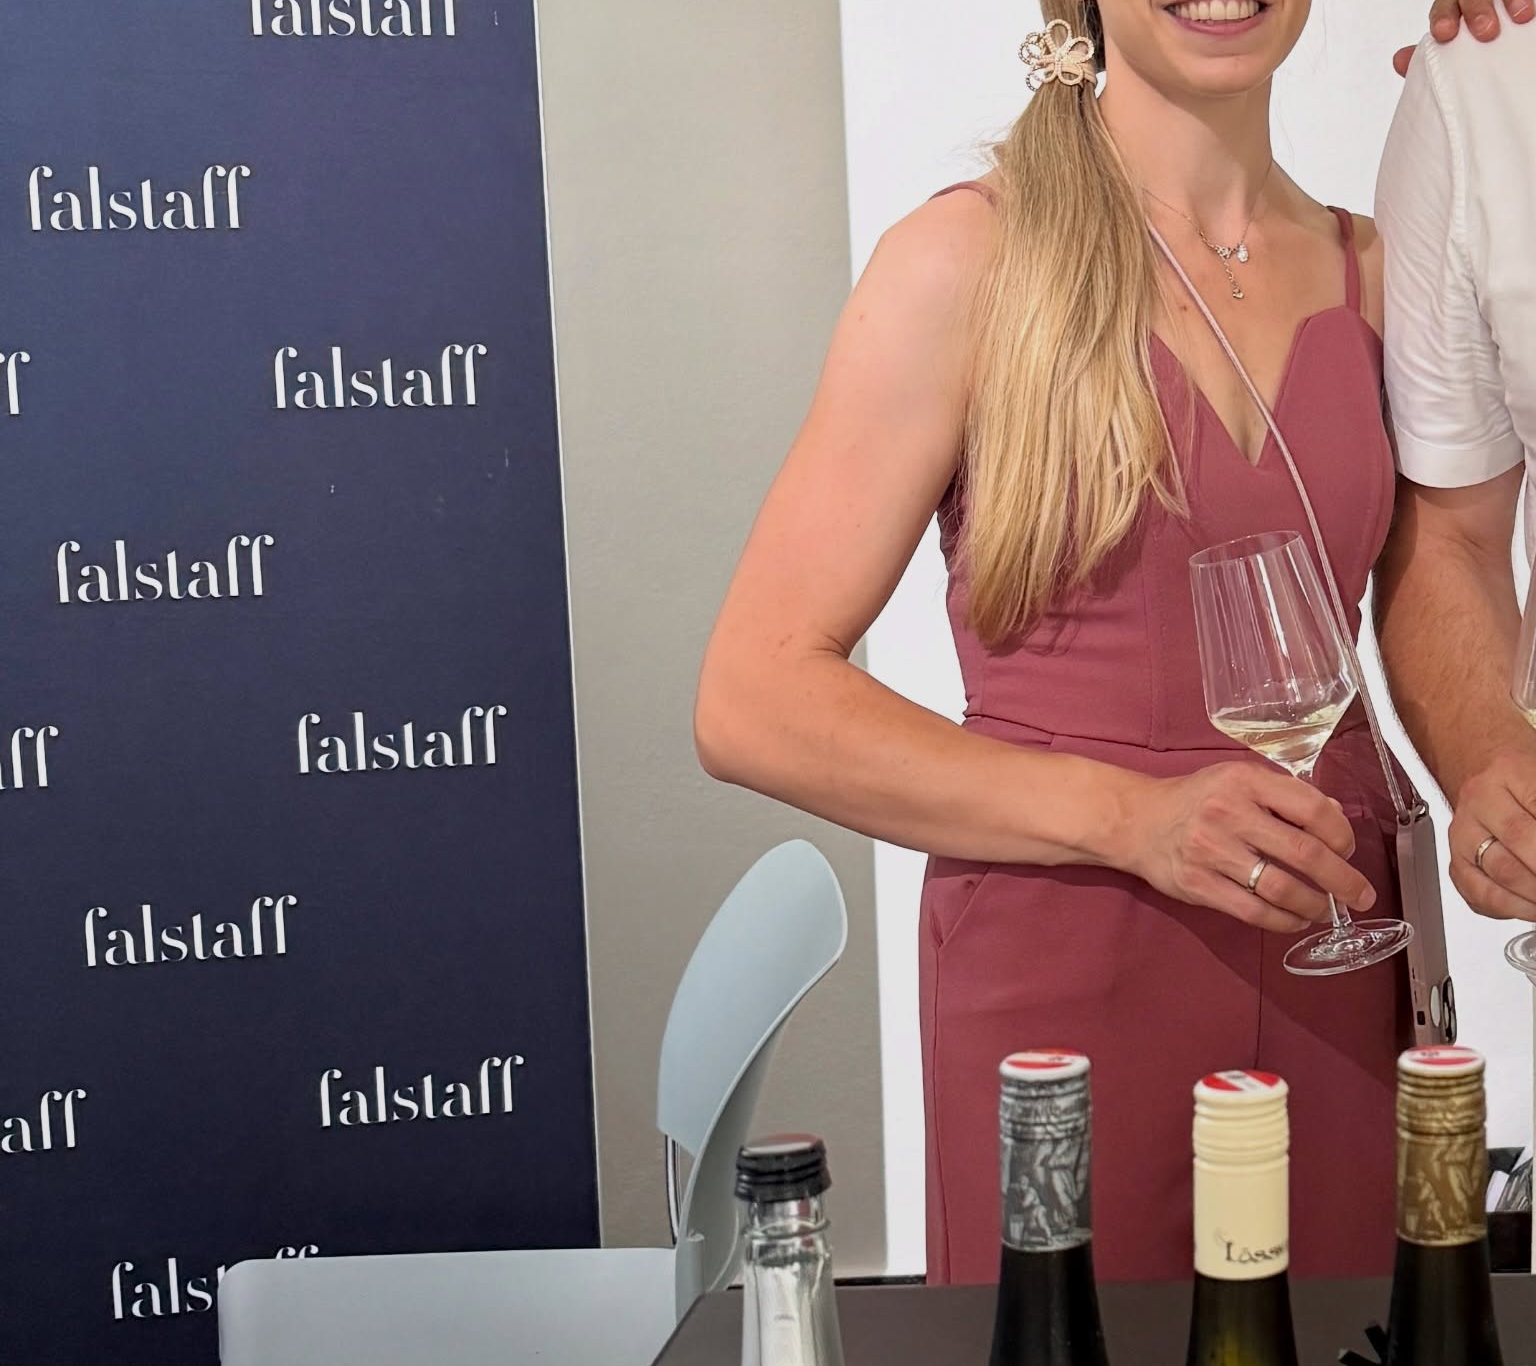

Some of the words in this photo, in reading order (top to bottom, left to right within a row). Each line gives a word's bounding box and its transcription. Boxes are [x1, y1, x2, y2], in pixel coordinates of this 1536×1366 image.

[29, 165, 250, 230] falstaff
[275, 344, 487, 408] falstaff
[58, 535, 274, 603] falstaff
[298, 705, 507, 773] falstaff
[85, 895, 297, 966] falstaff
[321, 1055, 524, 1126] falstaff
